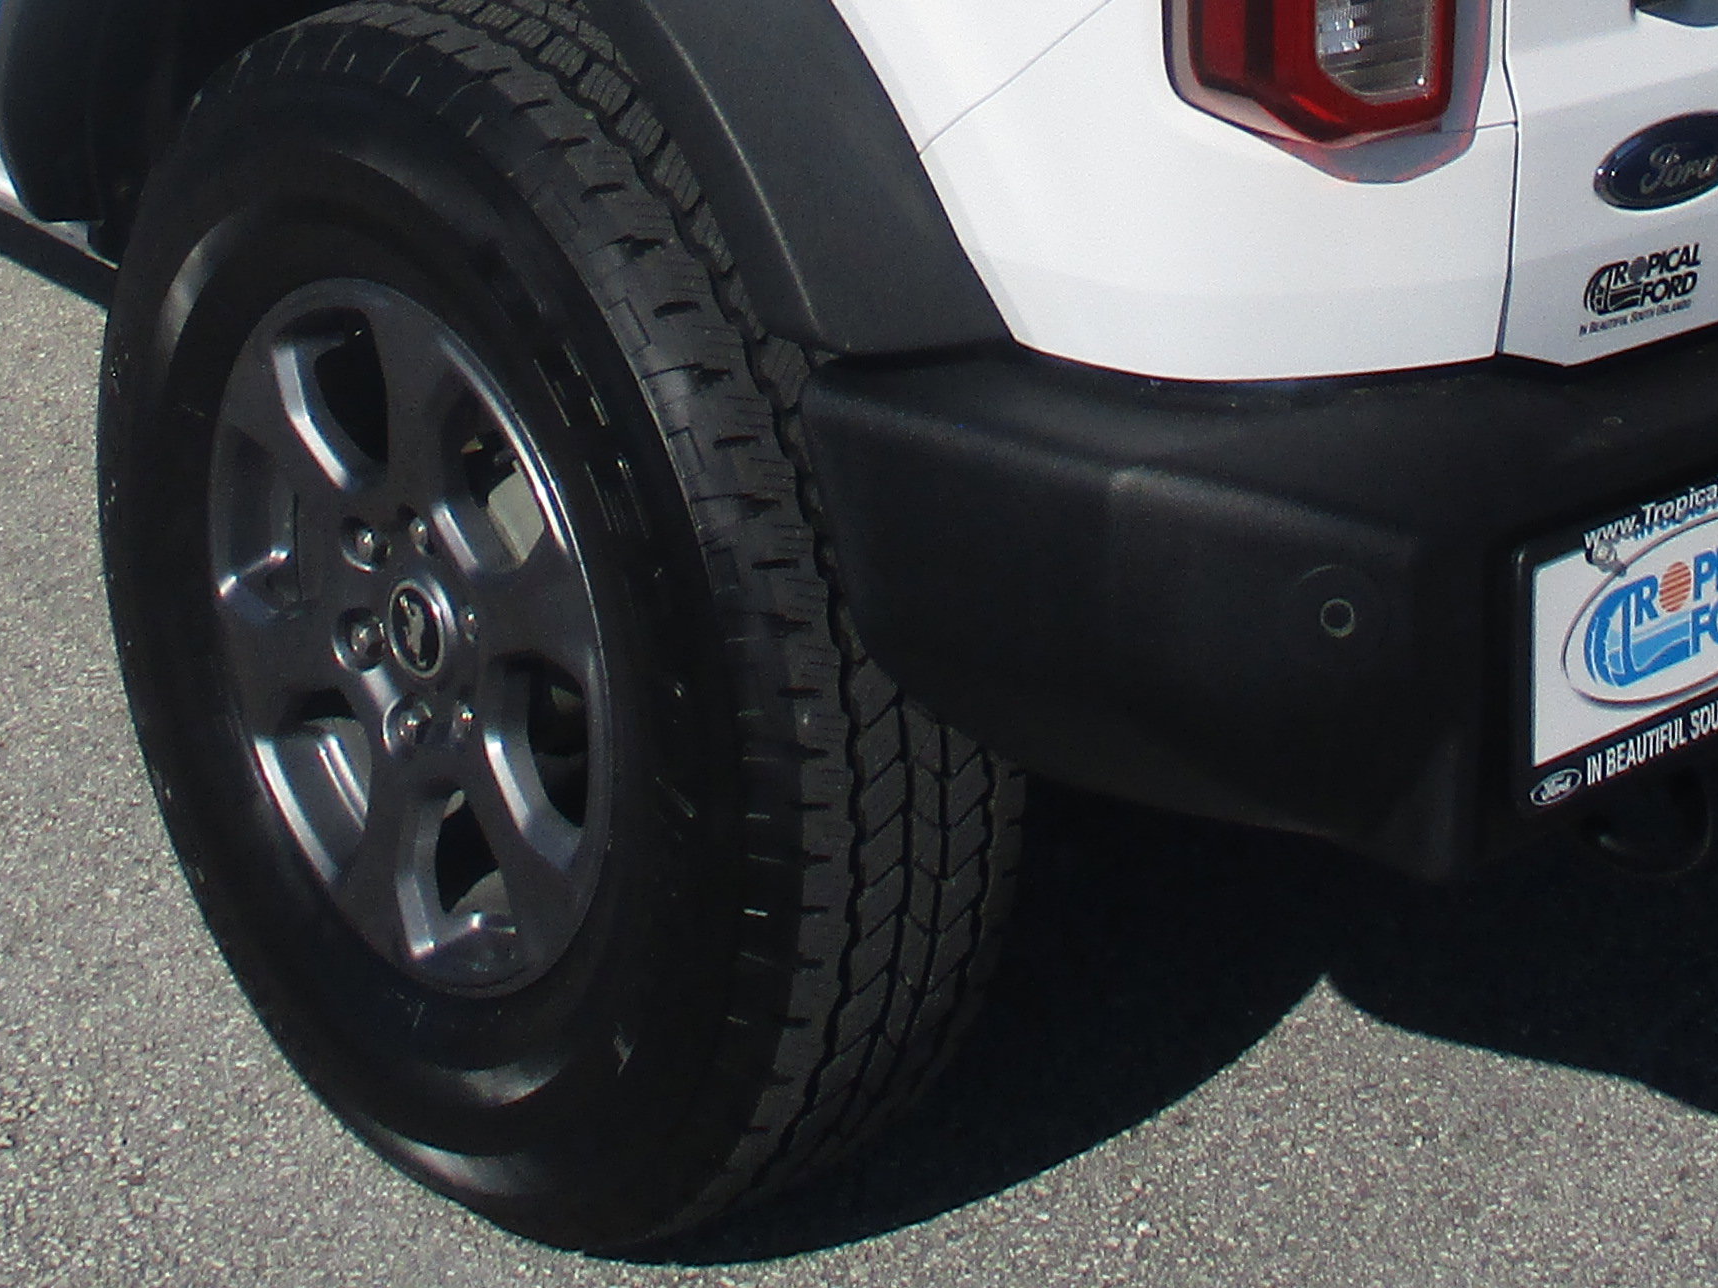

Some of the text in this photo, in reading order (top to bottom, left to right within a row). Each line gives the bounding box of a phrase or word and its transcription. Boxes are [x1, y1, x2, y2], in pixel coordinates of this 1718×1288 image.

[1584, 242, 1701, 316] TROPICAL
[1640, 271, 1698, 307] FORD
[1586, 754, 1603, 786] IN
[1606, 719, 1689, 778] BEAUTIFUL
